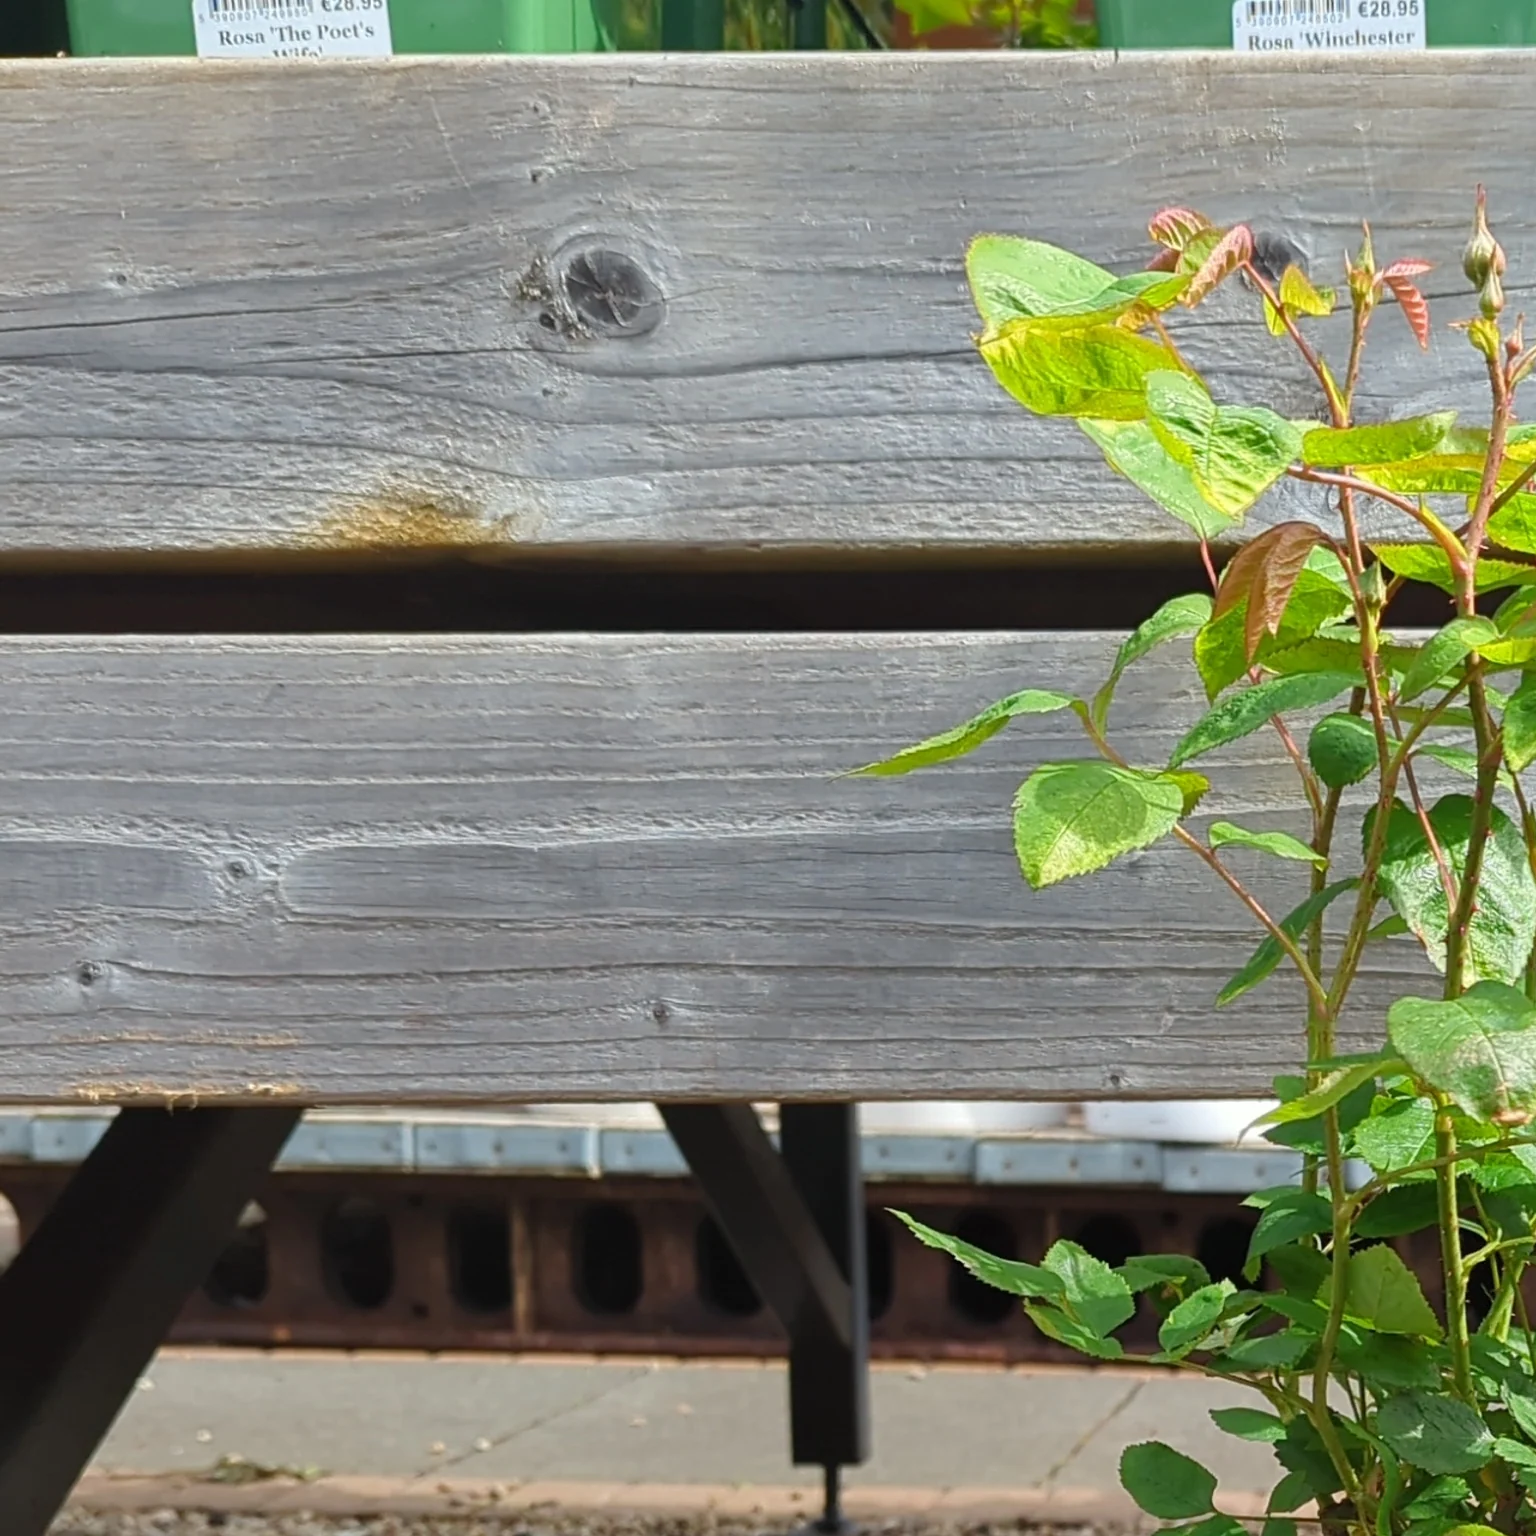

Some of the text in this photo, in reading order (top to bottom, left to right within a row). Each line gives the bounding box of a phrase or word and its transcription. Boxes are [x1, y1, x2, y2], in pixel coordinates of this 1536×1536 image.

[1358, 1, 1419, 18] €28.95
[218, 21, 375, 46] Rosa 'The Poet's
[1248, 29, 1415, 51] Rosa 'Winchester
